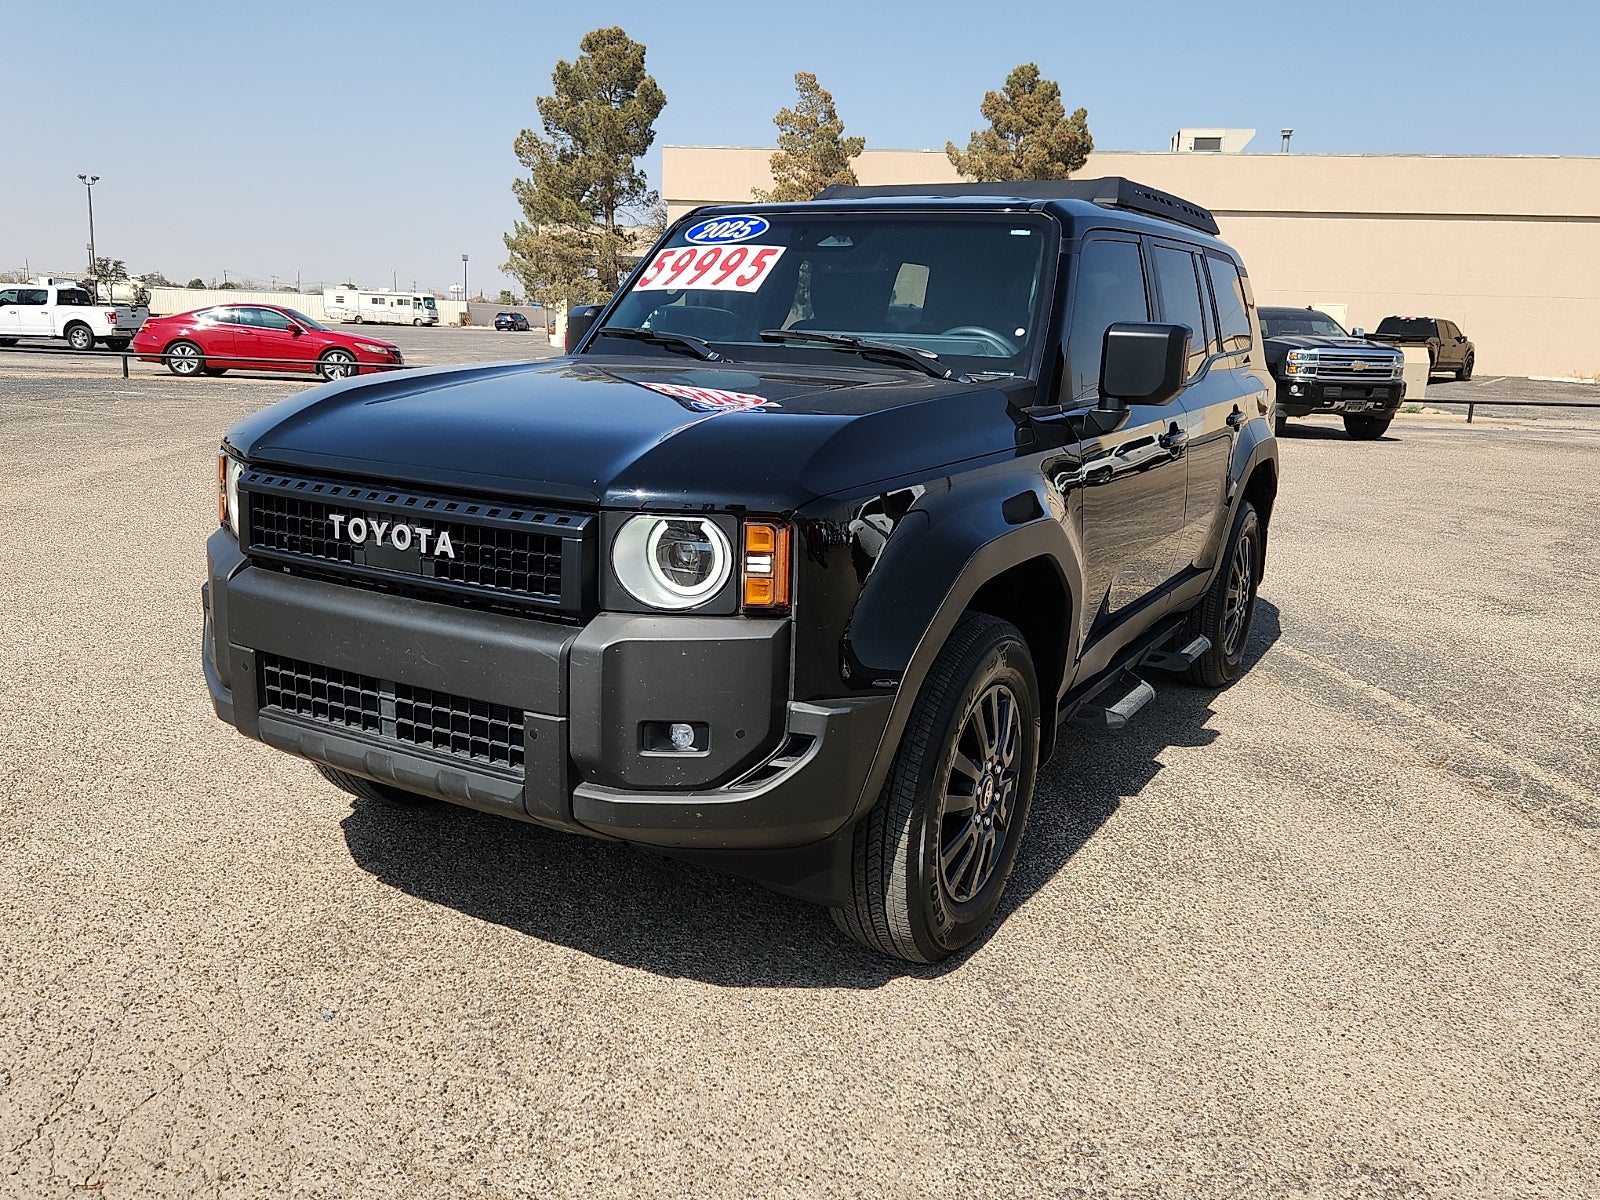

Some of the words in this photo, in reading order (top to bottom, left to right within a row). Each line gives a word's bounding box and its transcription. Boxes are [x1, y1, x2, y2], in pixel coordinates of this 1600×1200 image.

[693, 220, 760, 240] 2025
[639, 247, 780, 287] 59995
[329, 514, 455, 558] TOYOTA
